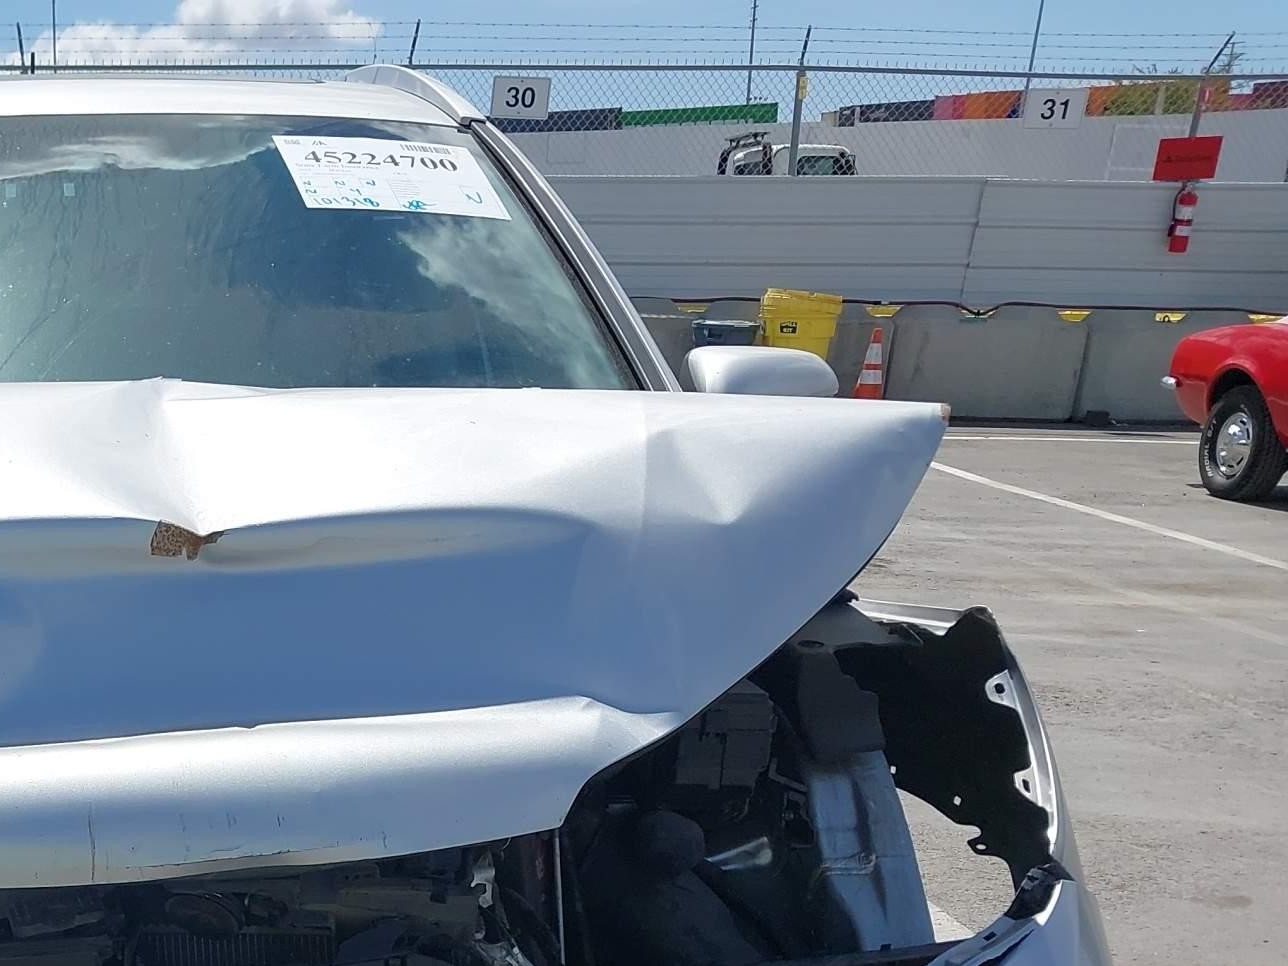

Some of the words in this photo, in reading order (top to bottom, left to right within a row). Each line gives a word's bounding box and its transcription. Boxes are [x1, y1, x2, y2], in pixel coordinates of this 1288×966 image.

[505, 86, 536, 109] 30
[1040, 98, 1070, 120] 31
[304, 150, 458, 173] 45224700
